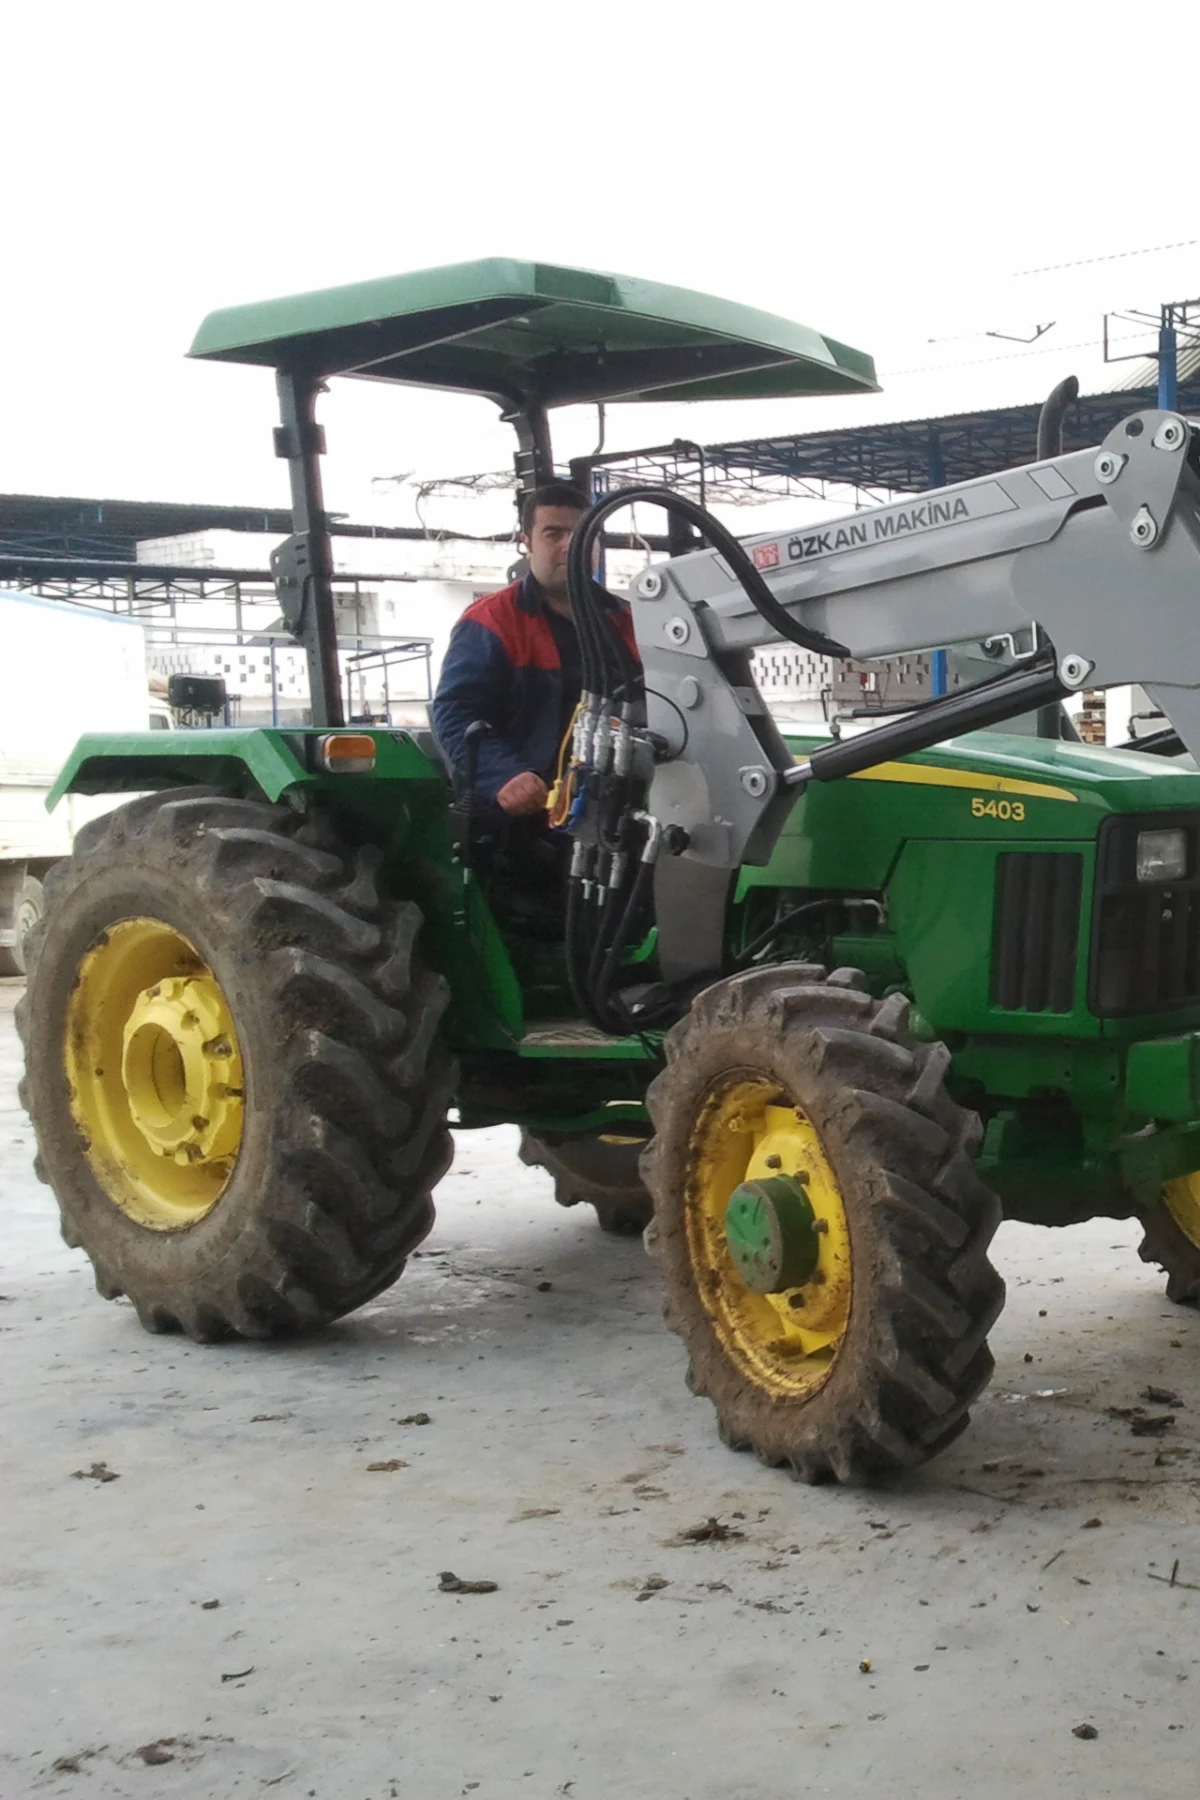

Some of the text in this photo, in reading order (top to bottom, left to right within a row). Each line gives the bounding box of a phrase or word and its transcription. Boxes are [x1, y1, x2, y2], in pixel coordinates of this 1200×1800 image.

[787, 522, 867, 561] ÖZKAN
[874, 497, 970, 540] MAKİNA
[971, 798, 1026, 822] 5403
